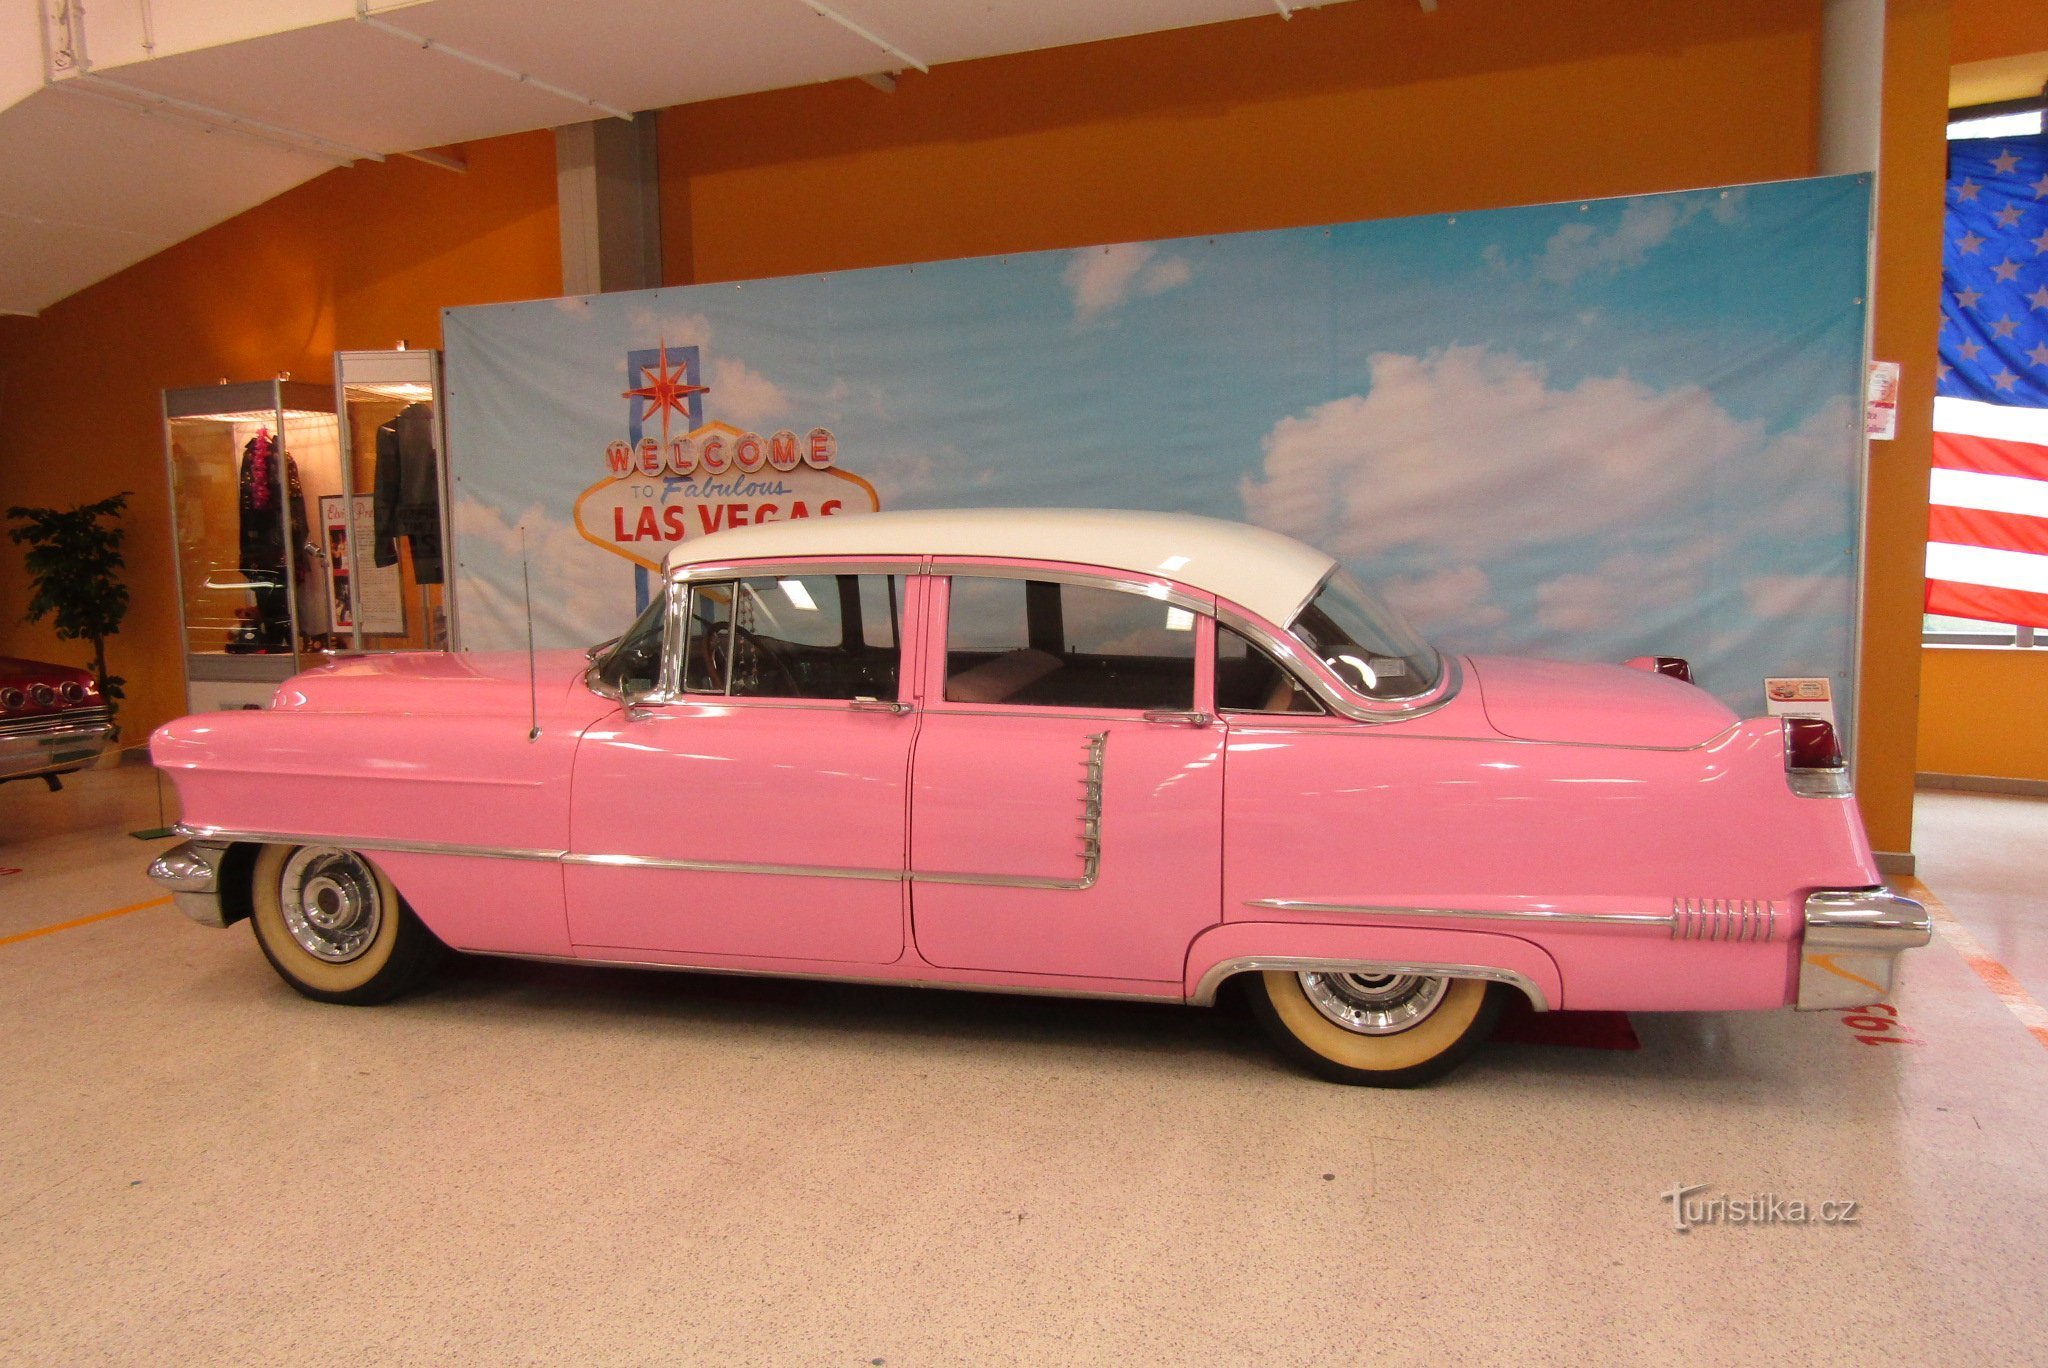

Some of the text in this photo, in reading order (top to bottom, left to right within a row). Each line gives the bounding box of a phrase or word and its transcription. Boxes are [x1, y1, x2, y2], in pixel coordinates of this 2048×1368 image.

[608, 436, 829, 472] WELCOME
[631, 474, 792, 504] TO Fabulous
[614, 504, 685, 542] LAS
